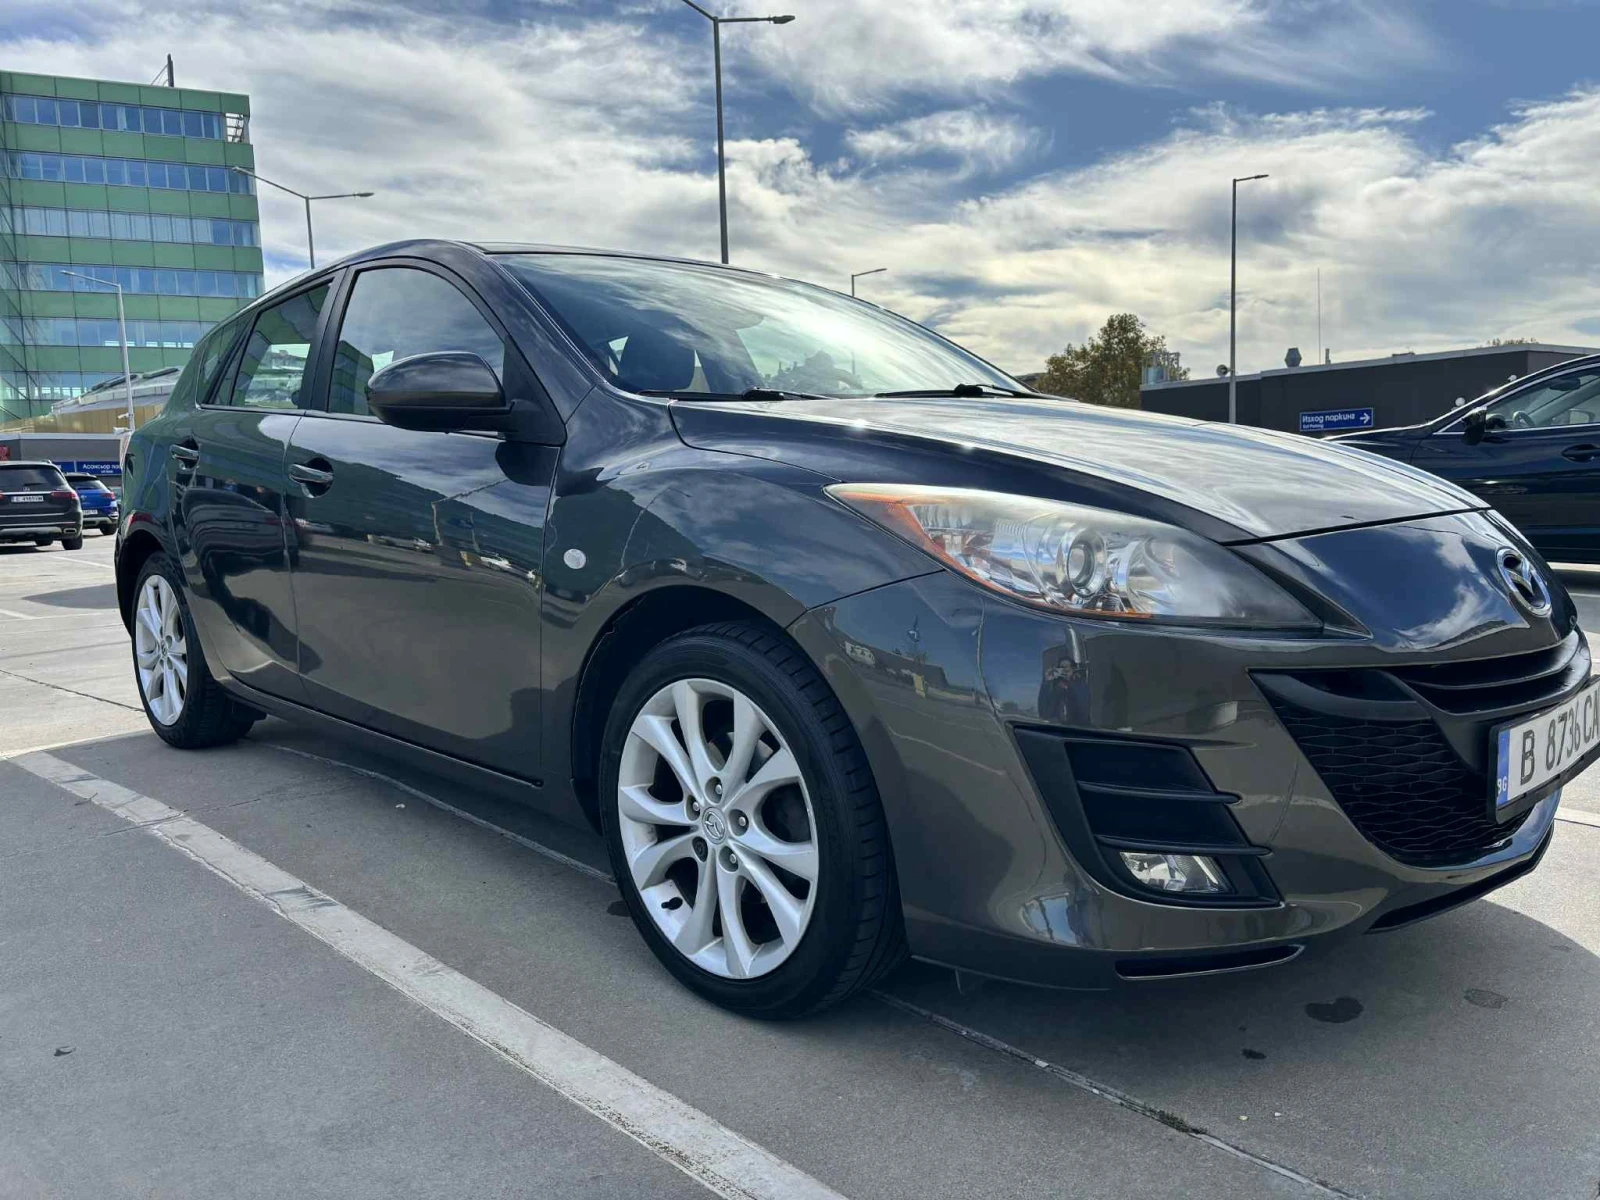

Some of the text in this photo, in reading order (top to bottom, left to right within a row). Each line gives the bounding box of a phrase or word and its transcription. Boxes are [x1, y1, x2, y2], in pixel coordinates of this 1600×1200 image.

[1302, 415, 1324, 424] Изход
[1520, 729, 1535, 786] B
[1546, 700, 1581, 772] 8736
